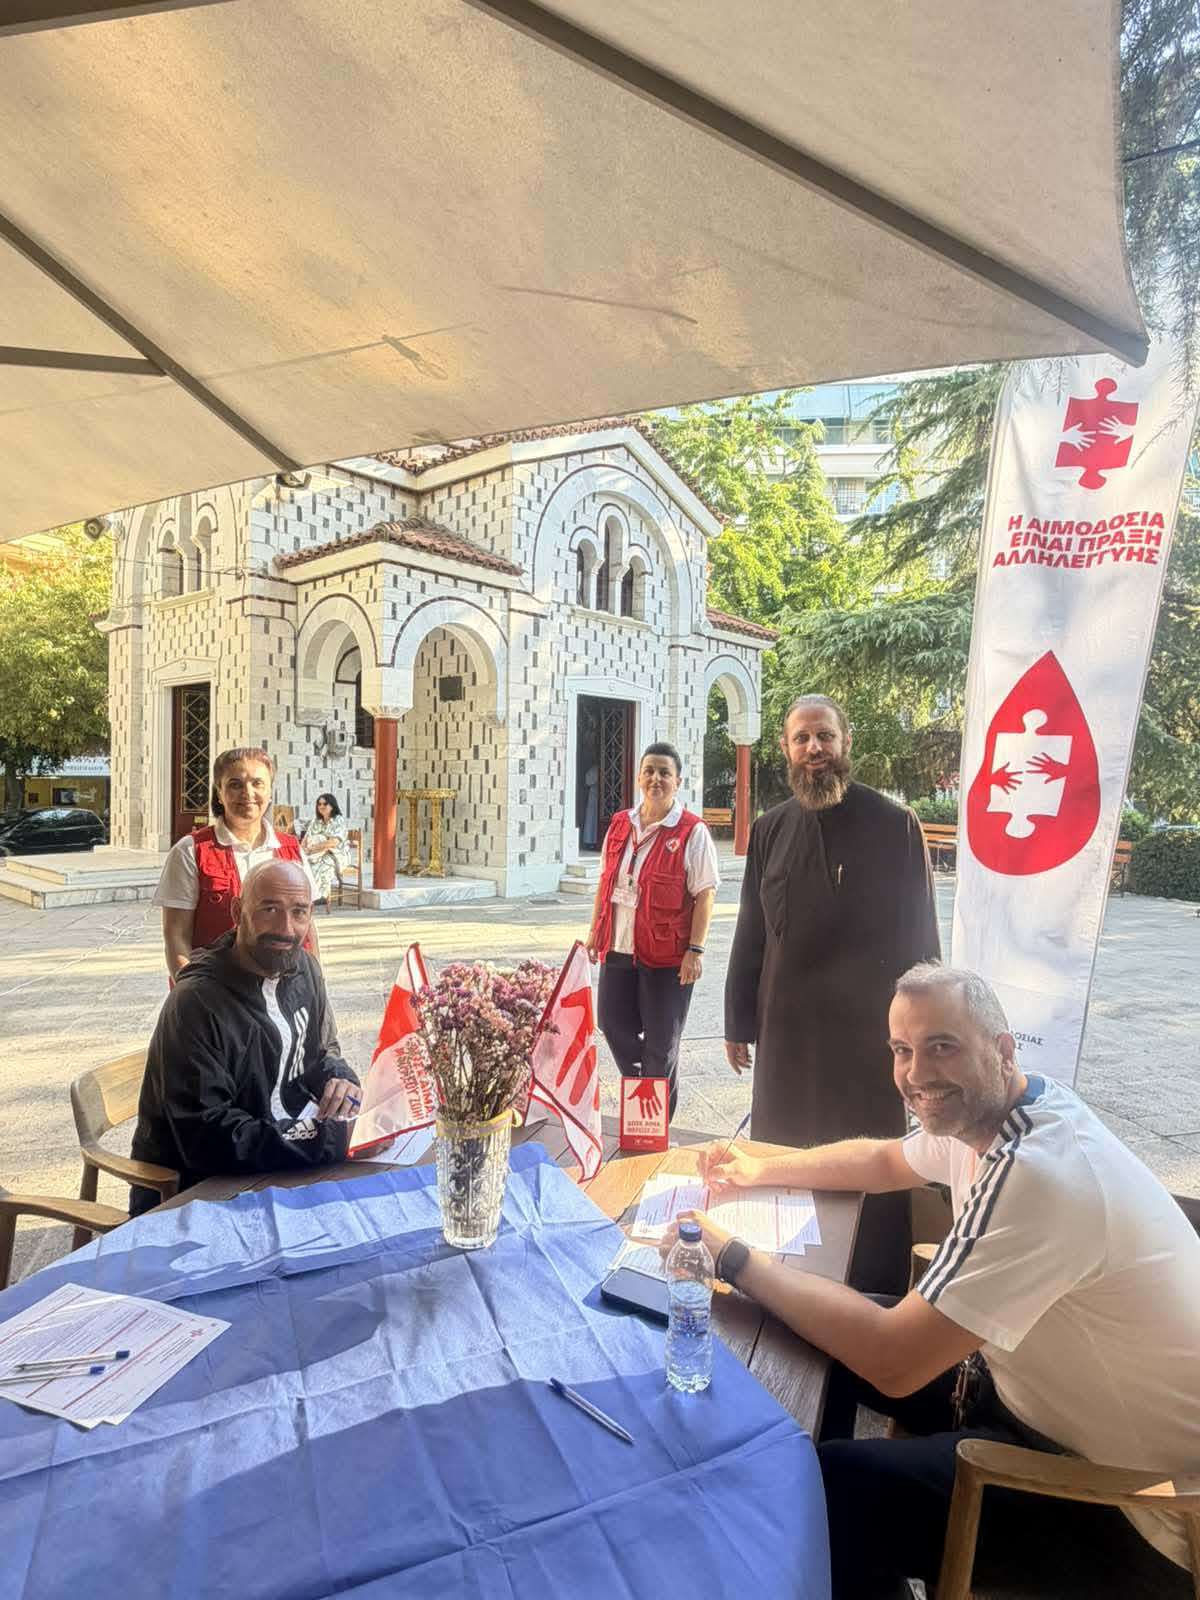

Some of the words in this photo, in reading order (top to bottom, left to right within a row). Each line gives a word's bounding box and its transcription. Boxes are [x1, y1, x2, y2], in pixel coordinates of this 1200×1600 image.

[1008, 514, 1022, 531] Η
[1027, 511, 1165, 536] ΑΙΜΟΔΟΣΙΑ
[1010, 531, 1072, 552] ΕΙΝΑΙ
[1077, 528, 1163, 552] ΠΡΑΞΗ
[993, 545, 1160, 568] ΑΛΛΗΛΕΓΓΥΗΣ
[1011, 1030, 1044, 1046] ΟΣΙΑΣ
